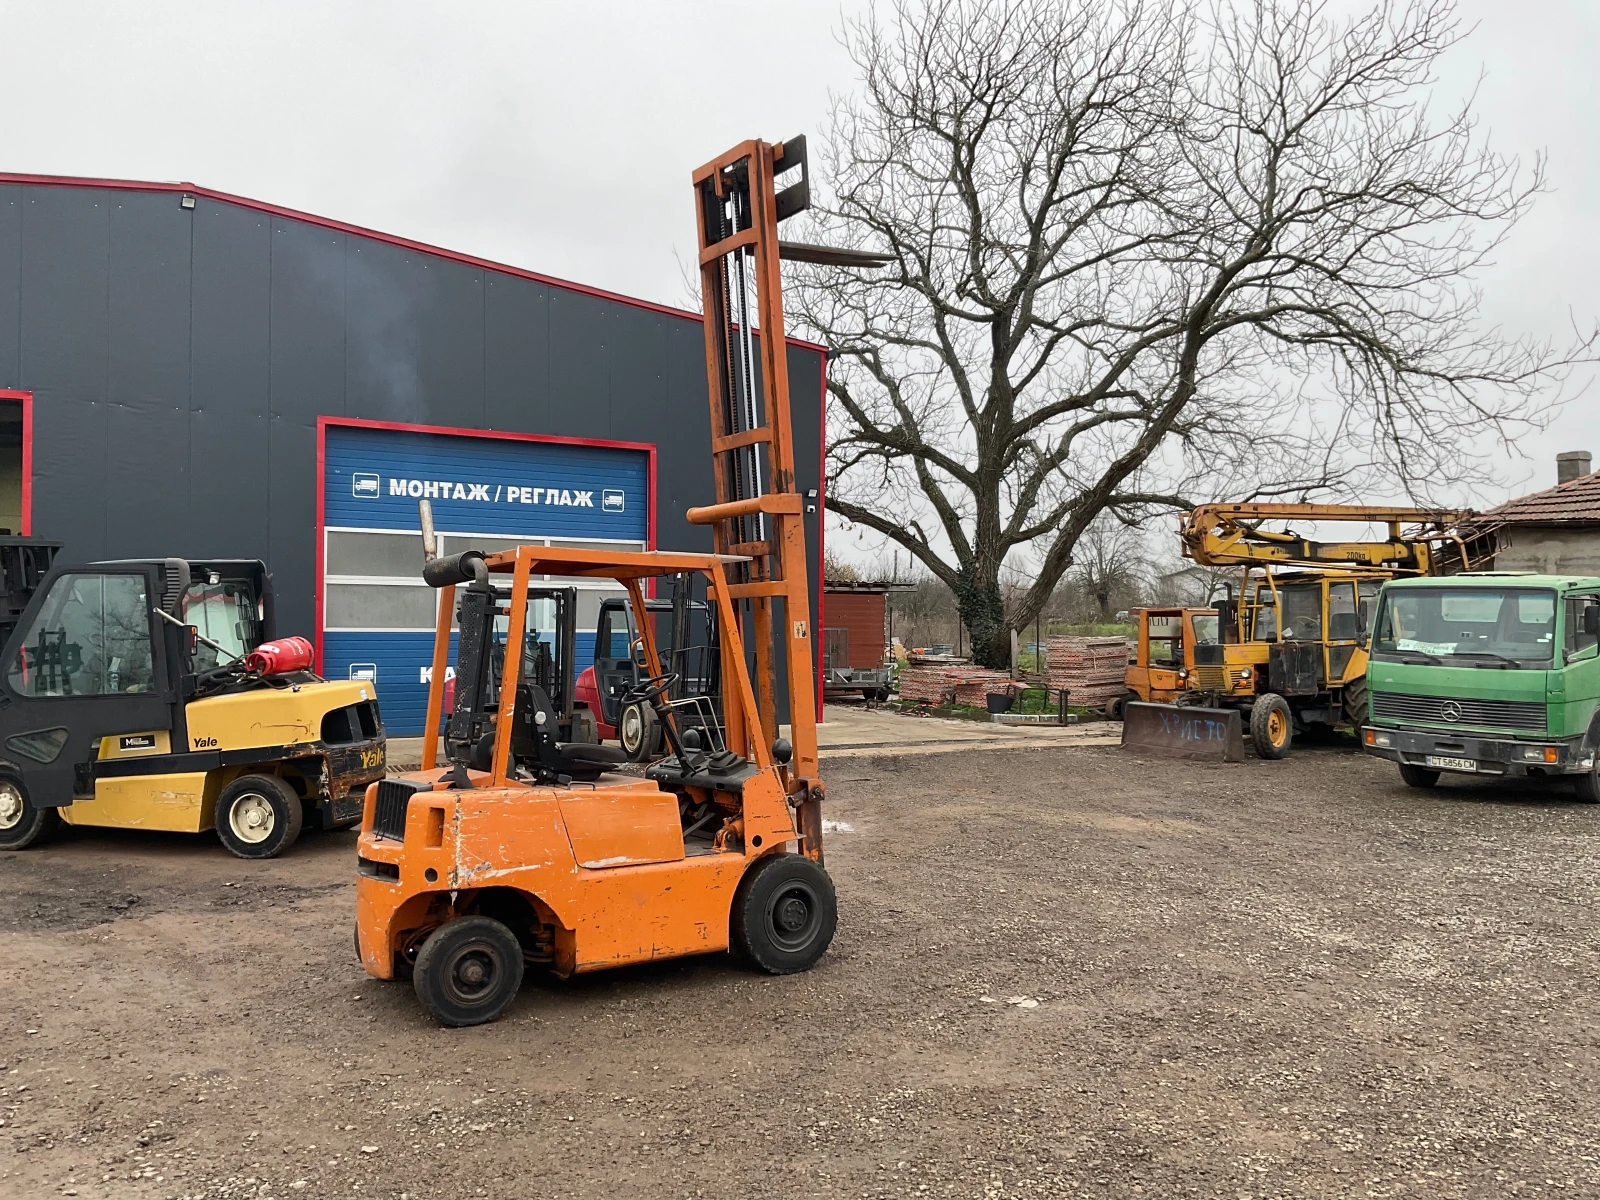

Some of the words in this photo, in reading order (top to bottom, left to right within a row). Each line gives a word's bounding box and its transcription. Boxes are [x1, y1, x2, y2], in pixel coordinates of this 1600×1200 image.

[389, 478, 490, 501] МОНТАЖ
[494, 485, 502, 503] /
[507, 486, 594, 507] РЕГЛАЖ
[194, 737, 217, 748] Yale
[361, 748, 384, 769] Yale
[1443, 758, 1462, 768] 5856
[1463, 760, 1475, 769] CM
